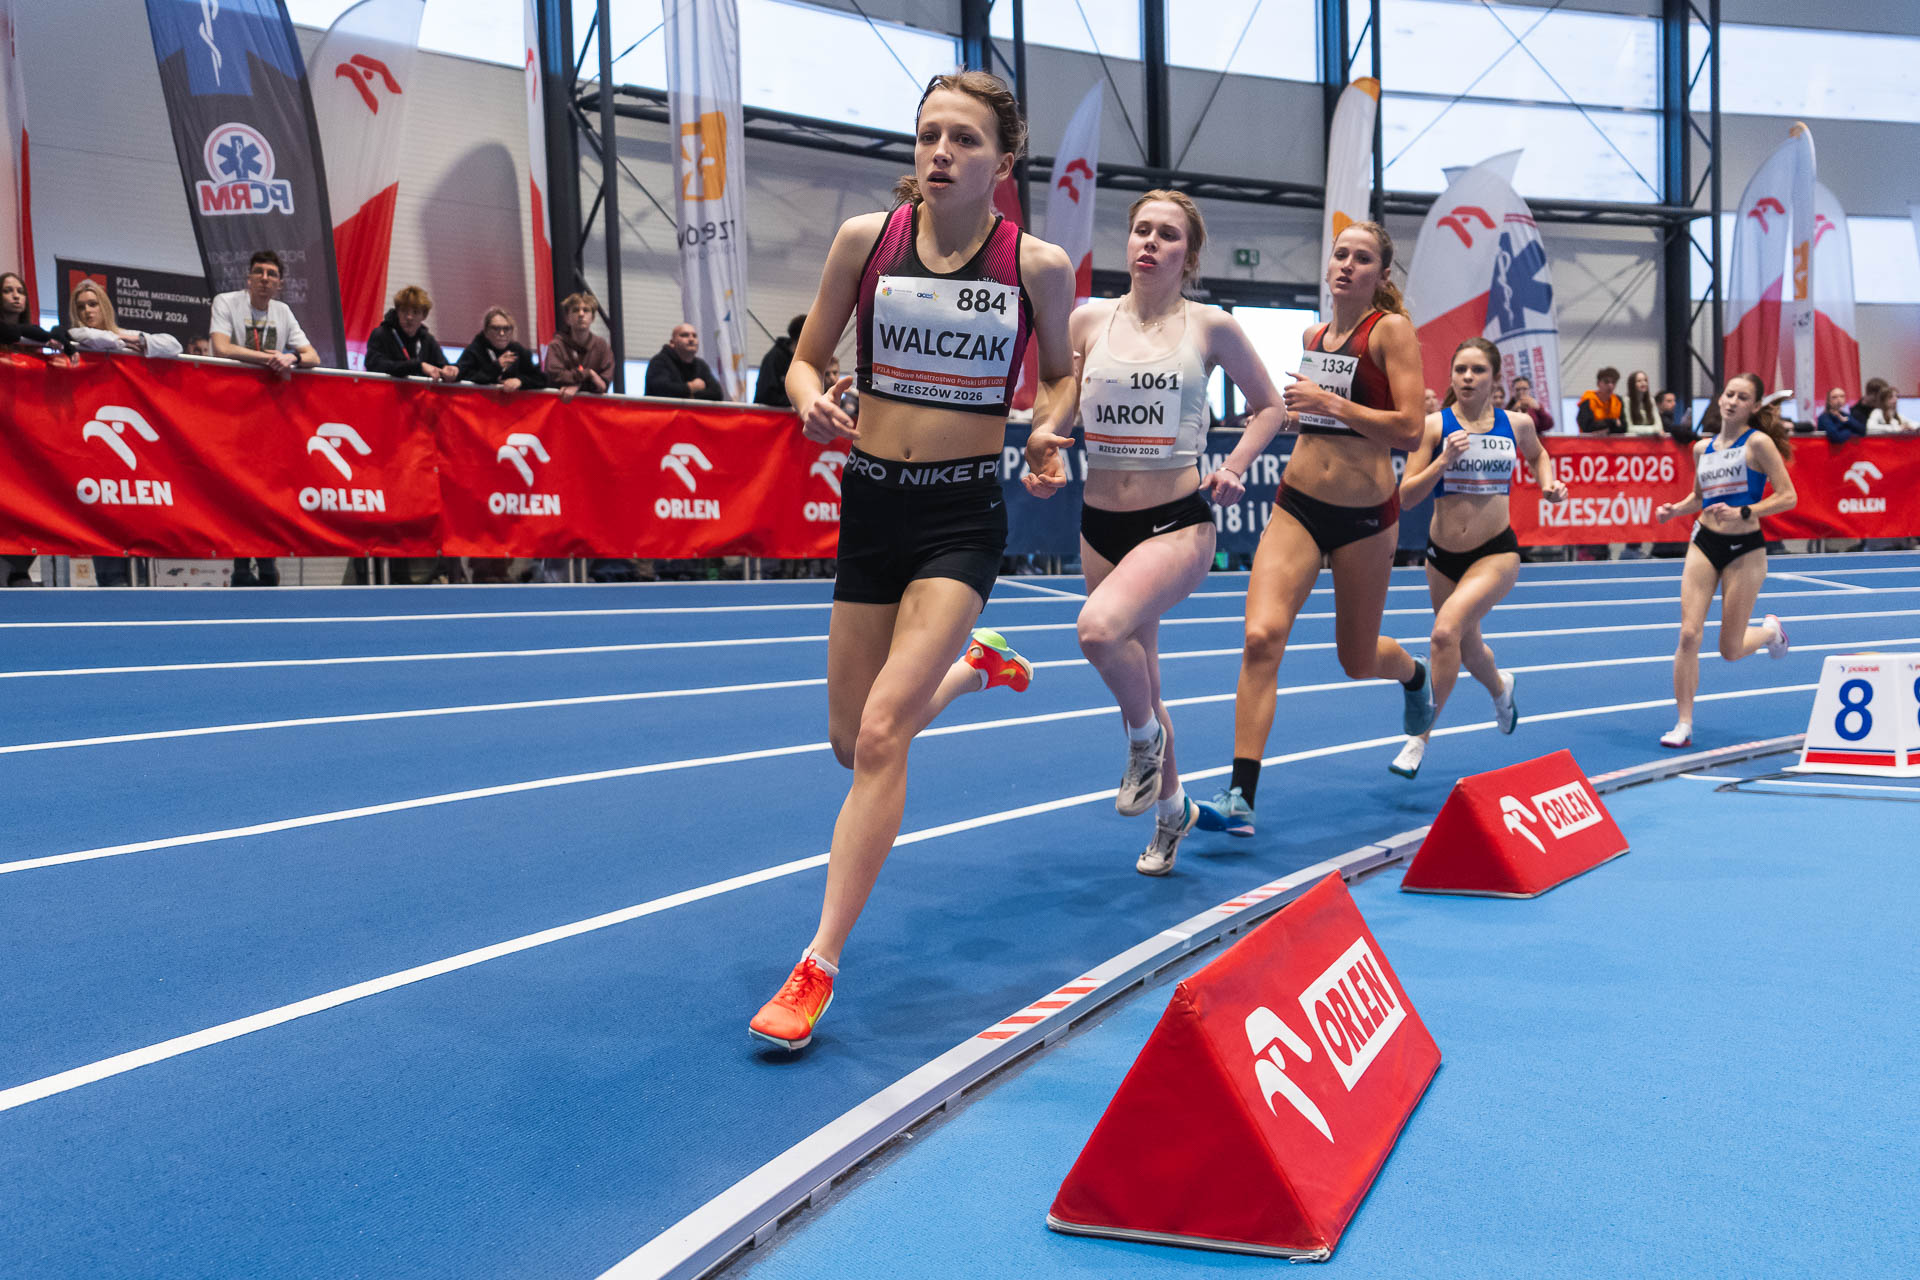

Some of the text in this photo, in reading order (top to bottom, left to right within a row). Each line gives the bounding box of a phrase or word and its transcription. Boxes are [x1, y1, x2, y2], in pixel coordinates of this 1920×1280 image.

[116, 277, 140, 288] PZLA
[116, 288, 150, 299] HALOWE
[956, 288, 1007, 315] 884
[117, 307, 188, 324] RZESZÓW 2026
[879, 323, 1010, 362] WALCZAK
[876, 366, 891, 375] PZLA
[891, 370, 914, 379] Halowe
[915, 373, 956, 385] Mistrzostwa
[957, 377, 977, 386] Polski
[1321, 358, 1356, 375] 1334
[893, 382, 983, 401] RZESZÓW 2026
[1130, 372, 1179, 390] 1061
[1096, 400, 1164, 425] JAROŃ
[1098, 444, 1160, 455] RZESZÓW 2026
[1482, 438, 1511, 450] 1017
[848, 451, 887, 480] PRO
[899, 464, 974, 485] NIKE
[76, 477, 174, 506] ORLEN
[298, 486, 386, 512] ORLEN
[488, 491, 561, 516] ORLEN
[654, 498, 720, 520] ORLEN
[803, 501, 841, 522] ORL
[1538, 490, 1653, 527] RZESZÓW
[1838, 498, 1887, 514] ORLEN
[1212, 503, 1242, 533] 18
[1835, 678, 1874, 741] 8
[1541, 788, 1594, 830] ORLEN
[1314, 953, 1396, 1067] ORLEN
